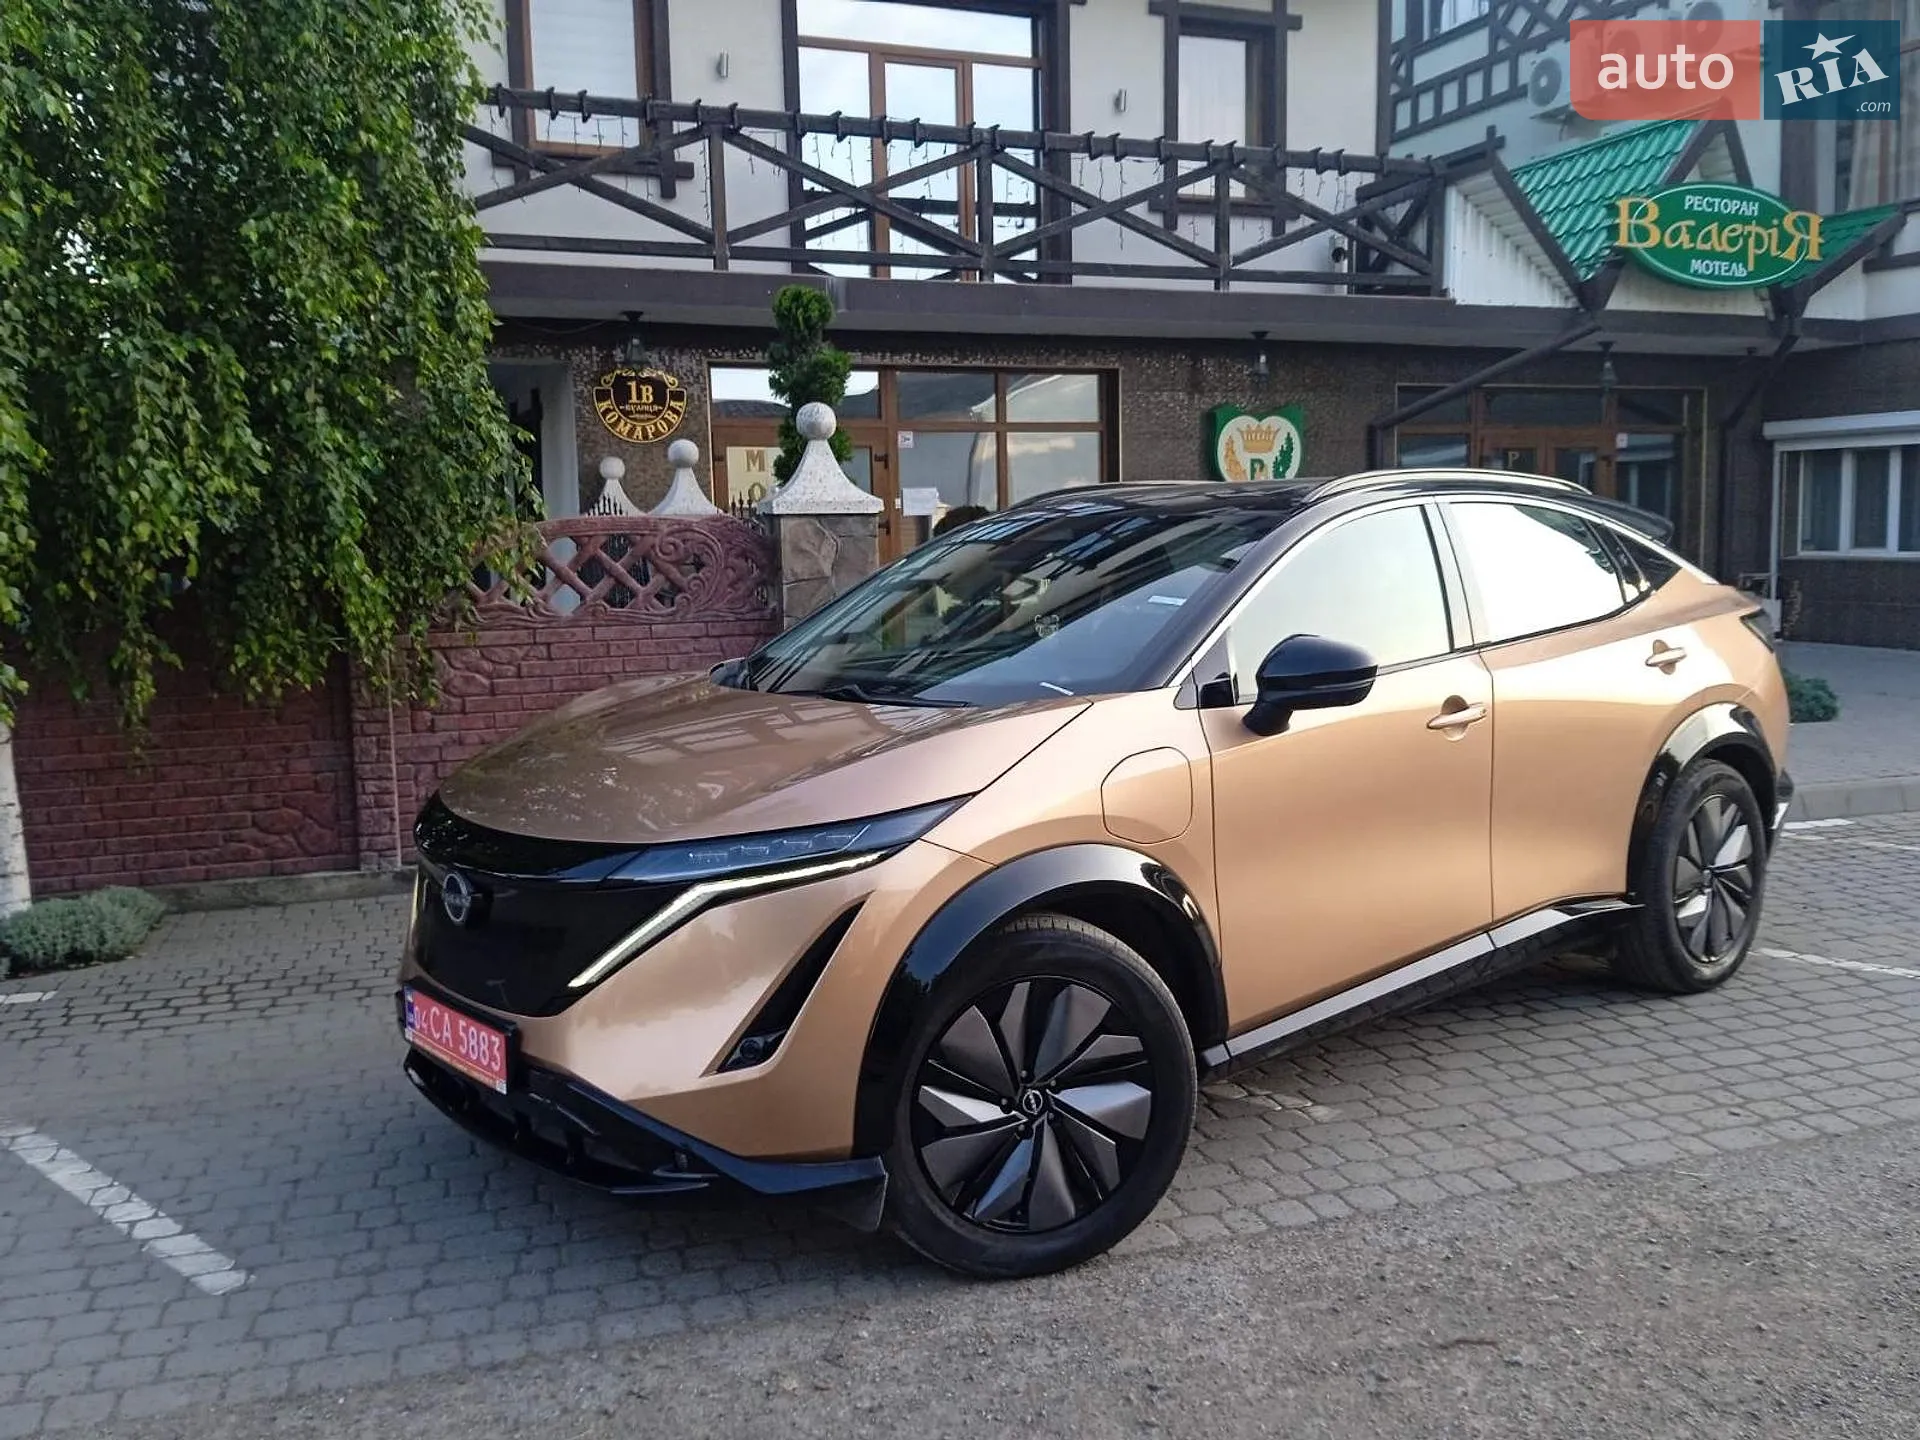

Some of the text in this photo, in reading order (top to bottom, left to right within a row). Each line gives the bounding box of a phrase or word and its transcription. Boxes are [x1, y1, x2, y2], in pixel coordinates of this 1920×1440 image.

[1684, 194, 1759, 217] РЕСТОРАН
[1690, 259, 1748, 278] МОТЕЛЬ
[597, 399, 685, 441] КОМАРОВА
[459, 1020, 501, 1072] 5883
